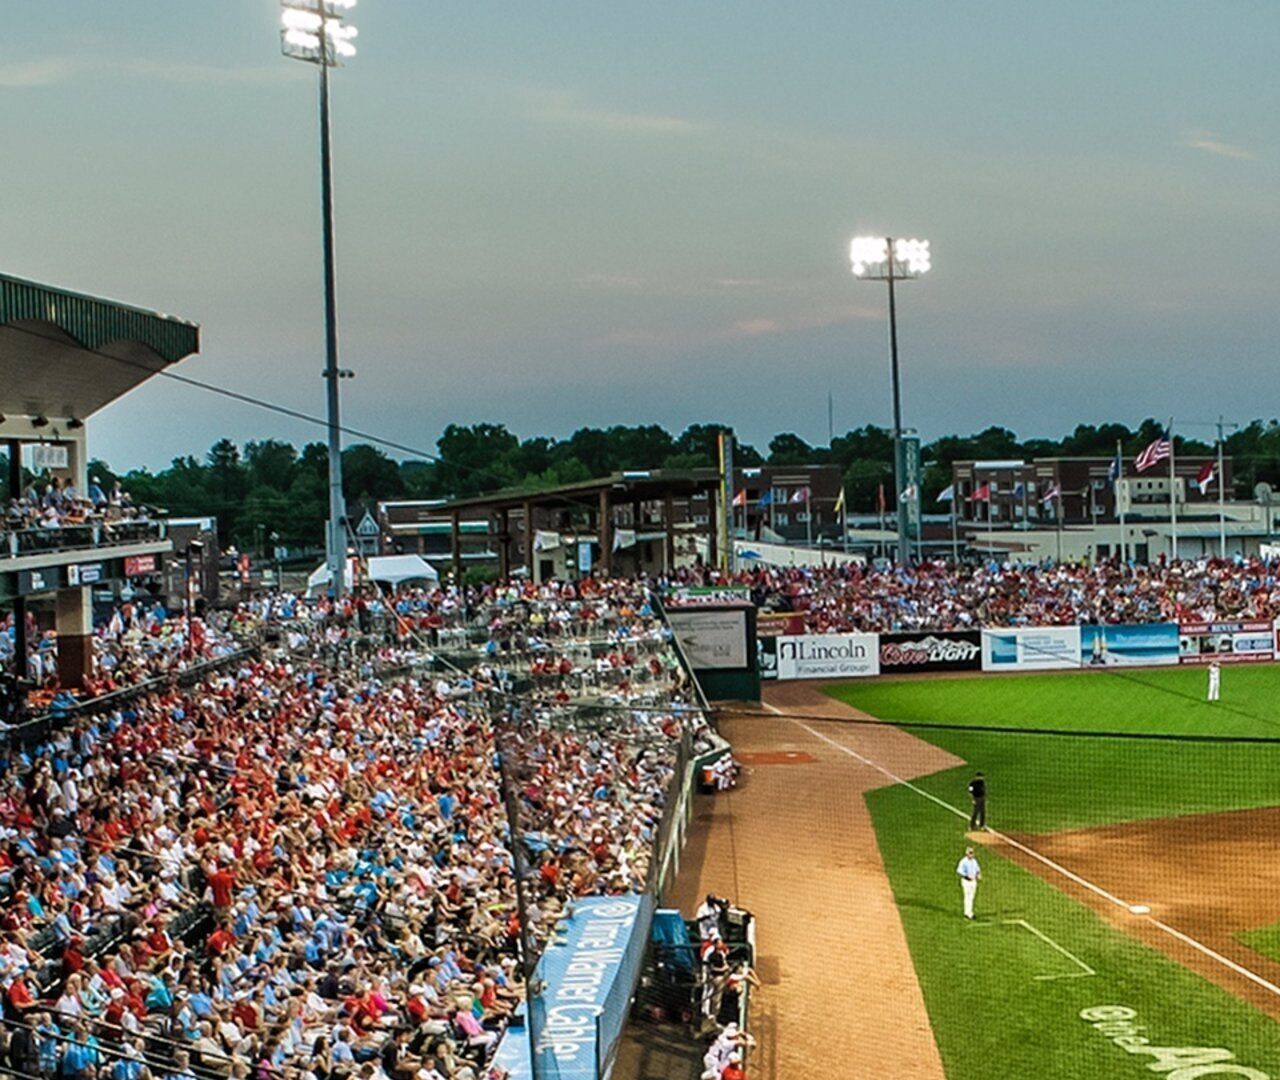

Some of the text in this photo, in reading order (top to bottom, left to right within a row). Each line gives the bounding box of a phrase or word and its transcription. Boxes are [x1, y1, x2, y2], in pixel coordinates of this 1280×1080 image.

[800, 640, 866, 660] Lincoln
[881, 643, 928, 665] Coors
[928, 646, 980, 662] LIGHT
[799, 664, 838, 675] Financial
[535, 919, 627, 1055] Time Warner Cable
